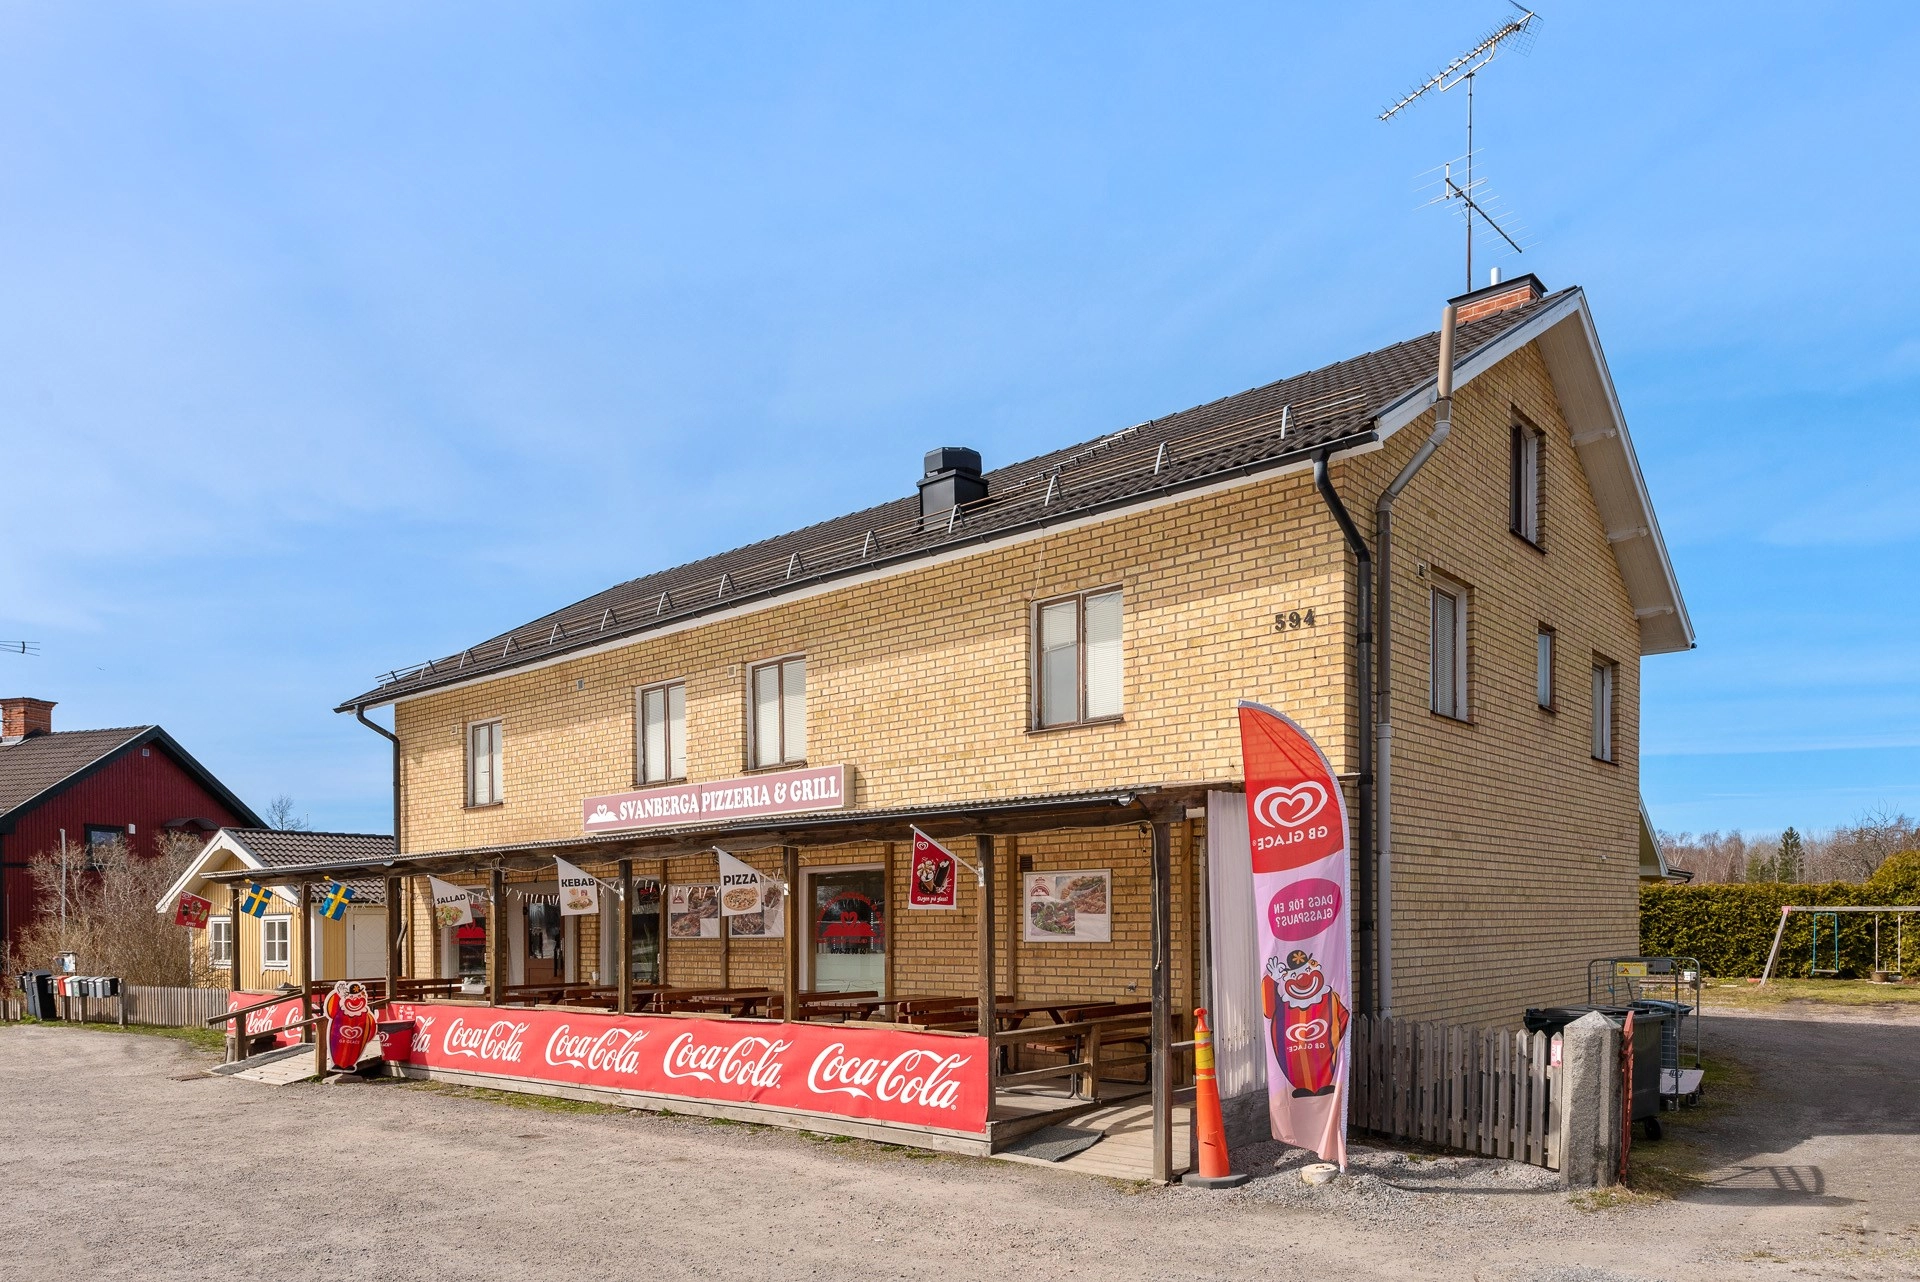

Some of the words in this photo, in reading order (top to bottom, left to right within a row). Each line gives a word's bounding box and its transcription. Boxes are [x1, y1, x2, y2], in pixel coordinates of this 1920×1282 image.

[1275, 609, 1315, 631] 594
[619, 793, 699, 821] SVANBERGA
[701, 784, 772, 813] PIZZERIA
[774, 782, 787, 803] &
[790, 775, 840, 802] GRILL
[561, 878, 596, 888] KEBAB
[723, 873, 758, 886] PIZZA
[436, 893, 466, 905] SALLAD
[443, 1017, 531, 1063] Coca-Cola
[545, 1024, 650, 1075] Coca-Cola
[662, 1032, 794, 1090] Coca-Cola
[807, 1042, 972, 1111] Coca-Cola
